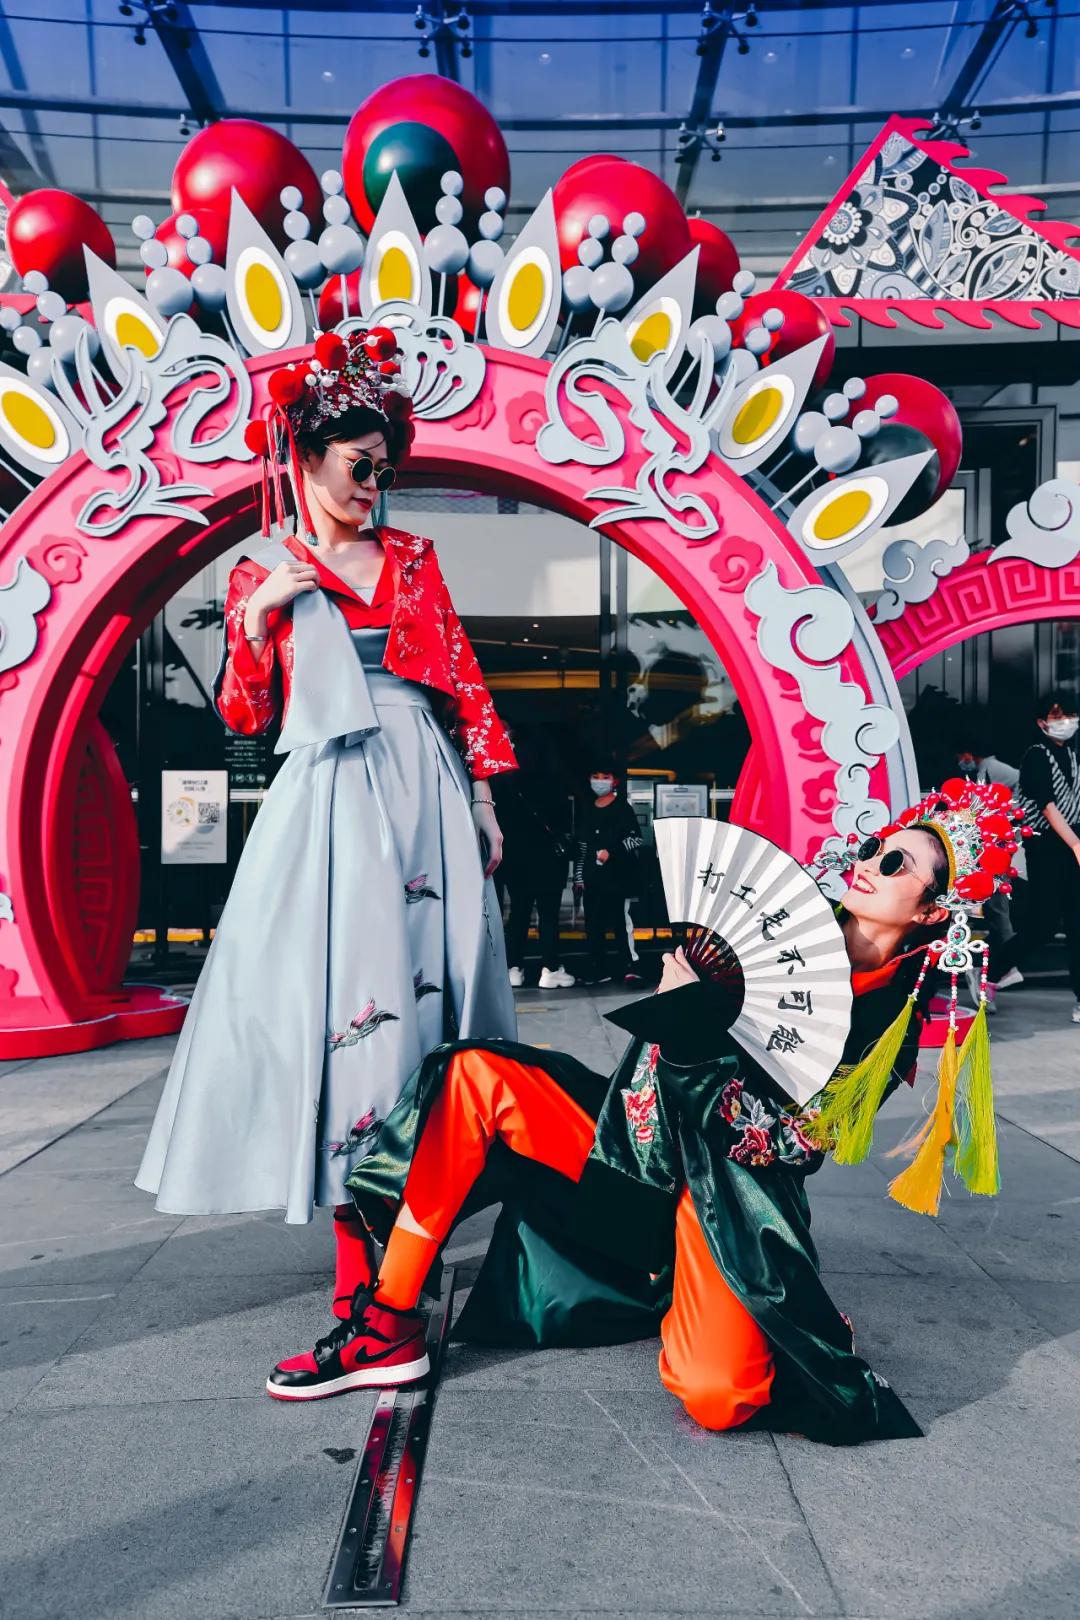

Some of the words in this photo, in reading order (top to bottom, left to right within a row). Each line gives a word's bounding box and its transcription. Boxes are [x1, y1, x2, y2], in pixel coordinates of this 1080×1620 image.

[697, 862, 814, 1053] 打工是不可能
